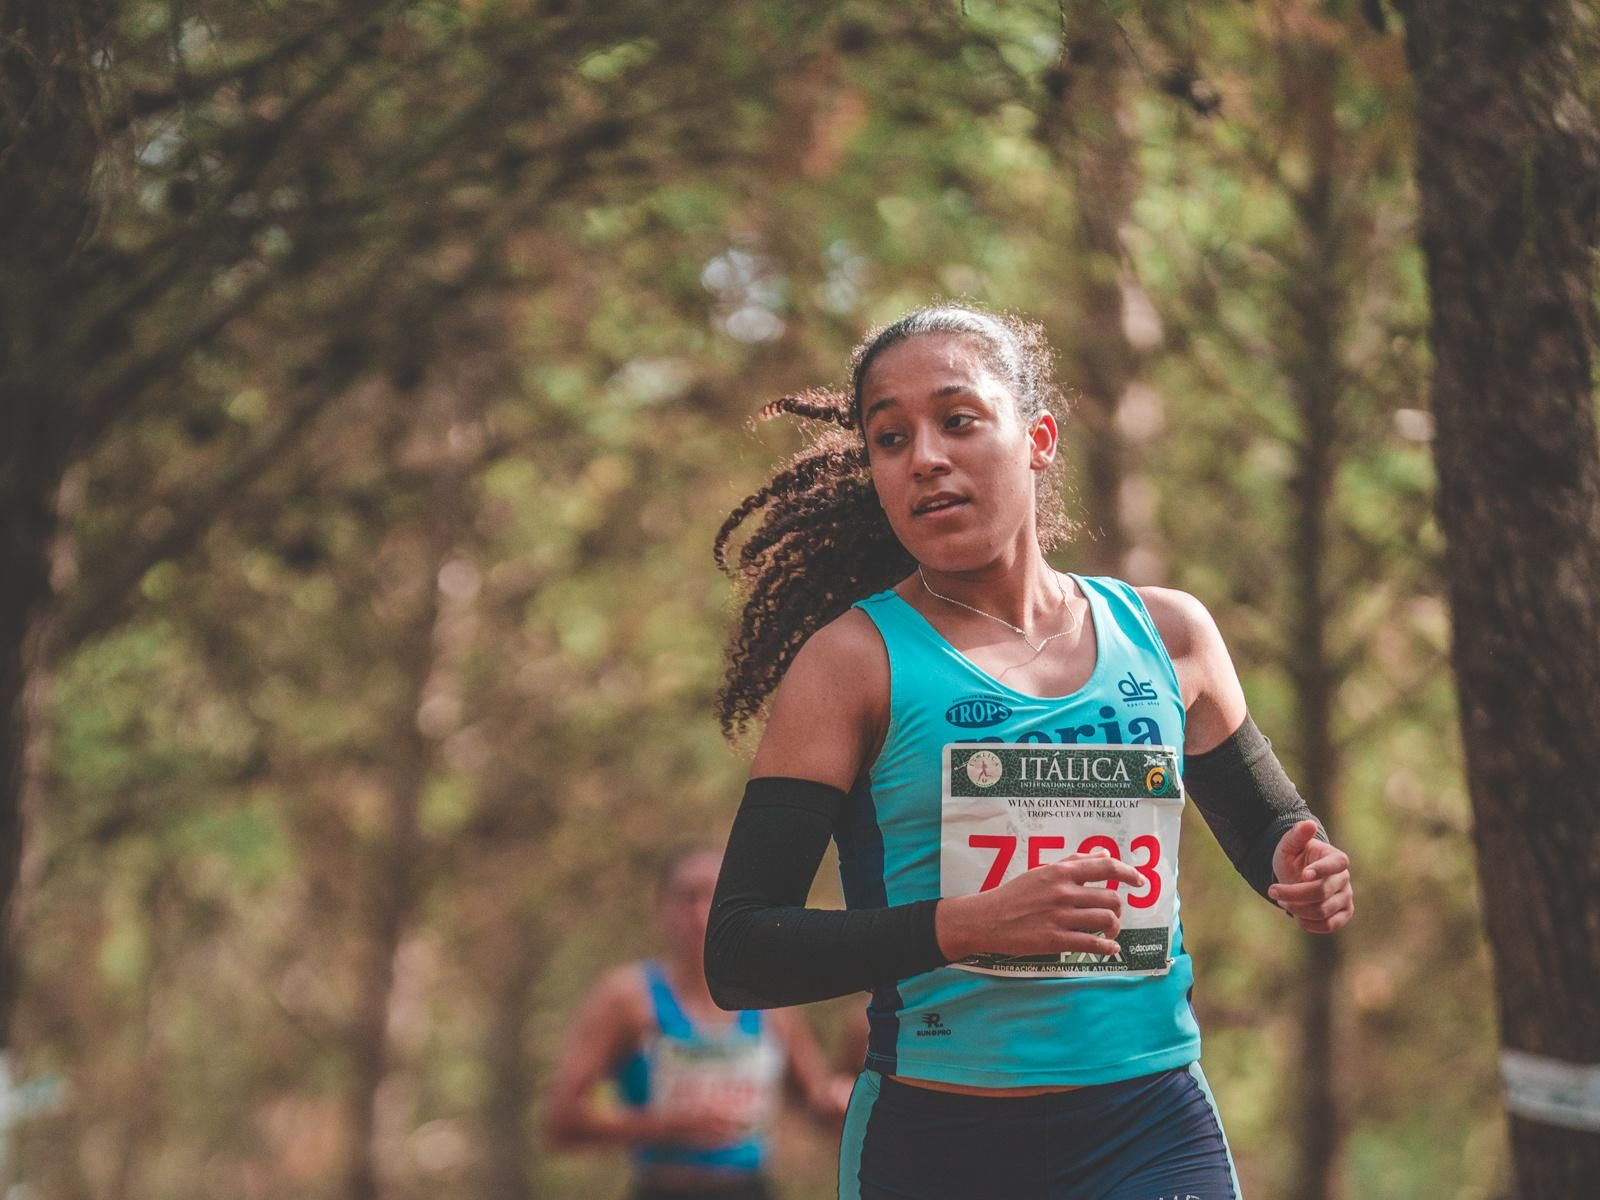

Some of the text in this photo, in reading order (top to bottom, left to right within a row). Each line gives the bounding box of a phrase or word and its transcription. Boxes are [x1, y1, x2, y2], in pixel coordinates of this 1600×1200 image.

[948, 701, 1010, 723] TROPS
[1019, 751, 1131, 781] ITÁLICA
[1008, 799, 1139, 809] WIAN GHANEMI MELLOUKI
[1027, 810, 1080, 818] TROPS-CUEVA
[1083, 810, 1094, 818] DE
[1041, 965, 1080, 973] ANDALUZA
